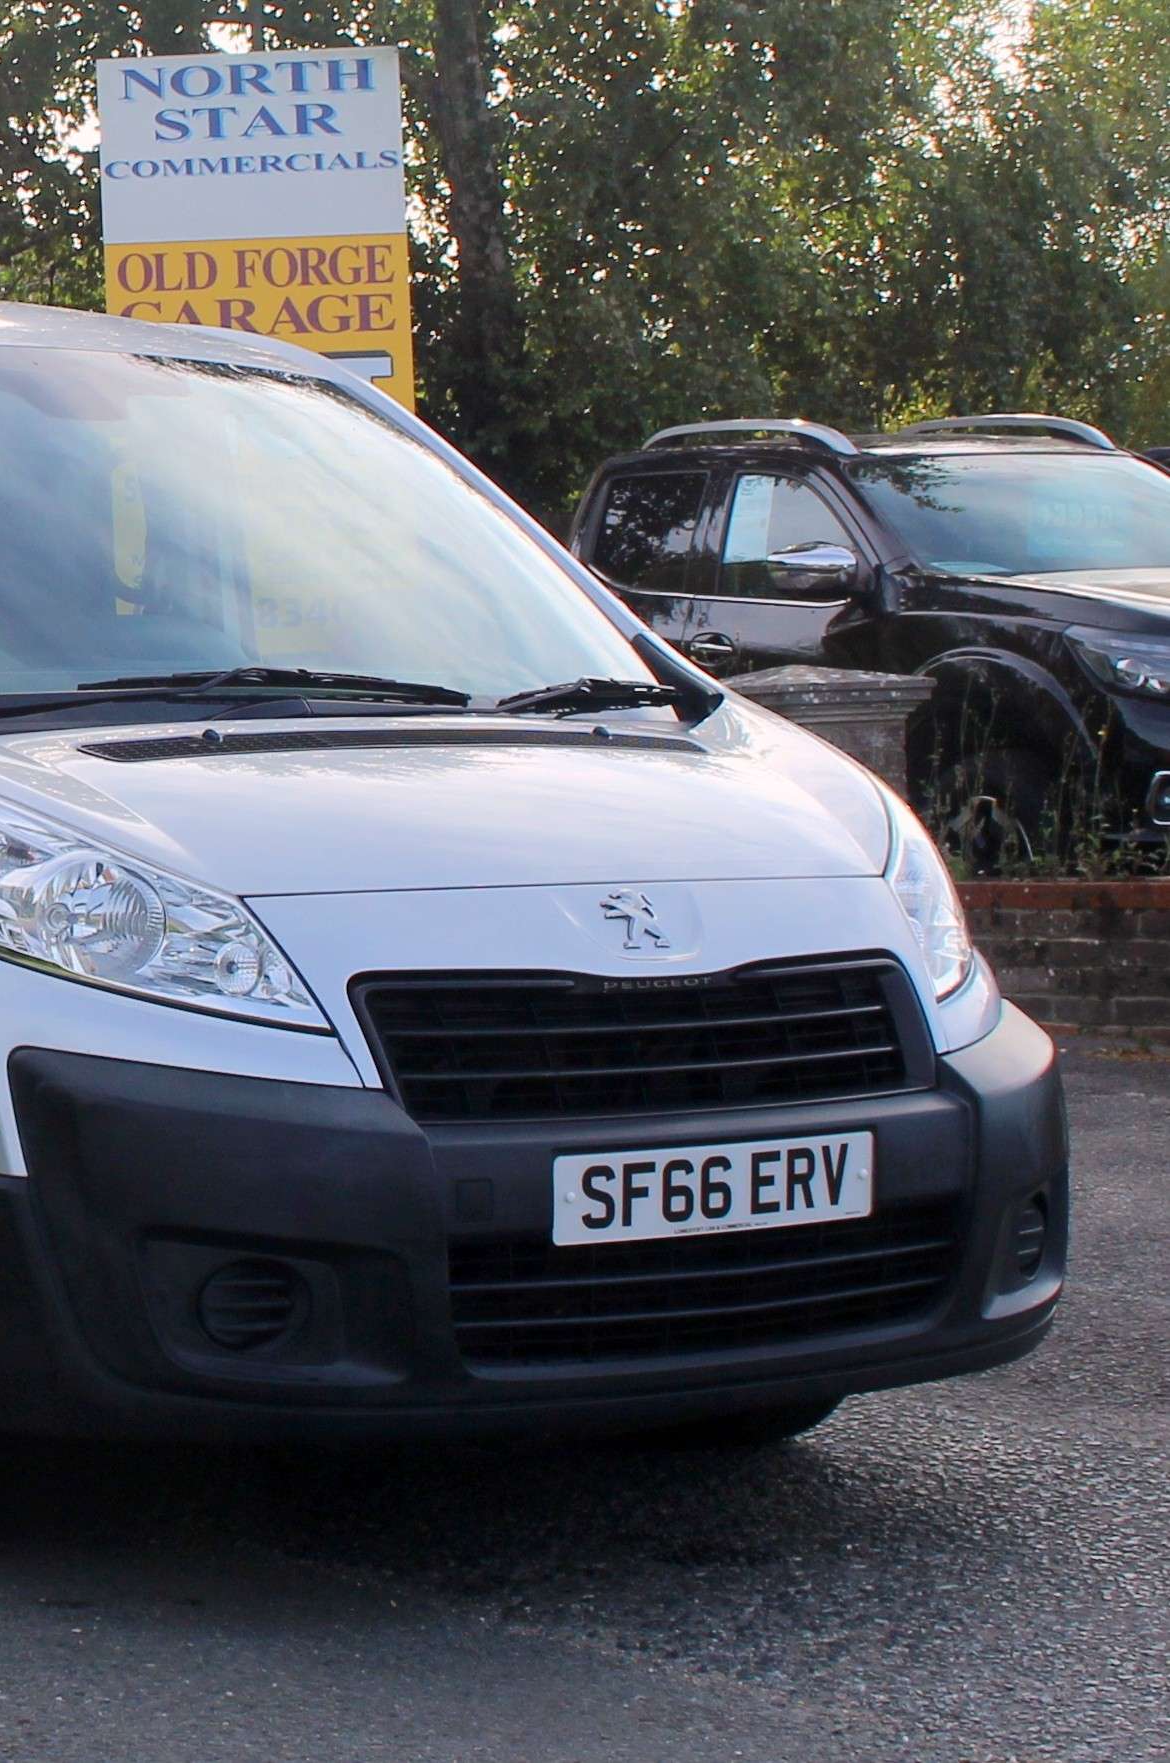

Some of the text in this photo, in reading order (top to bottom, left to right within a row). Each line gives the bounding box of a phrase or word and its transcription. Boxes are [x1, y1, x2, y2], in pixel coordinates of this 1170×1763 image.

[118, 57, 374, 101] NORTH
[154, 102, 342, 142] STAR
[104, 150, 399, 180] COMMERCIALS
[117, 243, 396, 294] OLD FORGE
[603, 976, 713, 994] PEUGEOT
[581, 1142, 849, 1229] SF66 ERV
